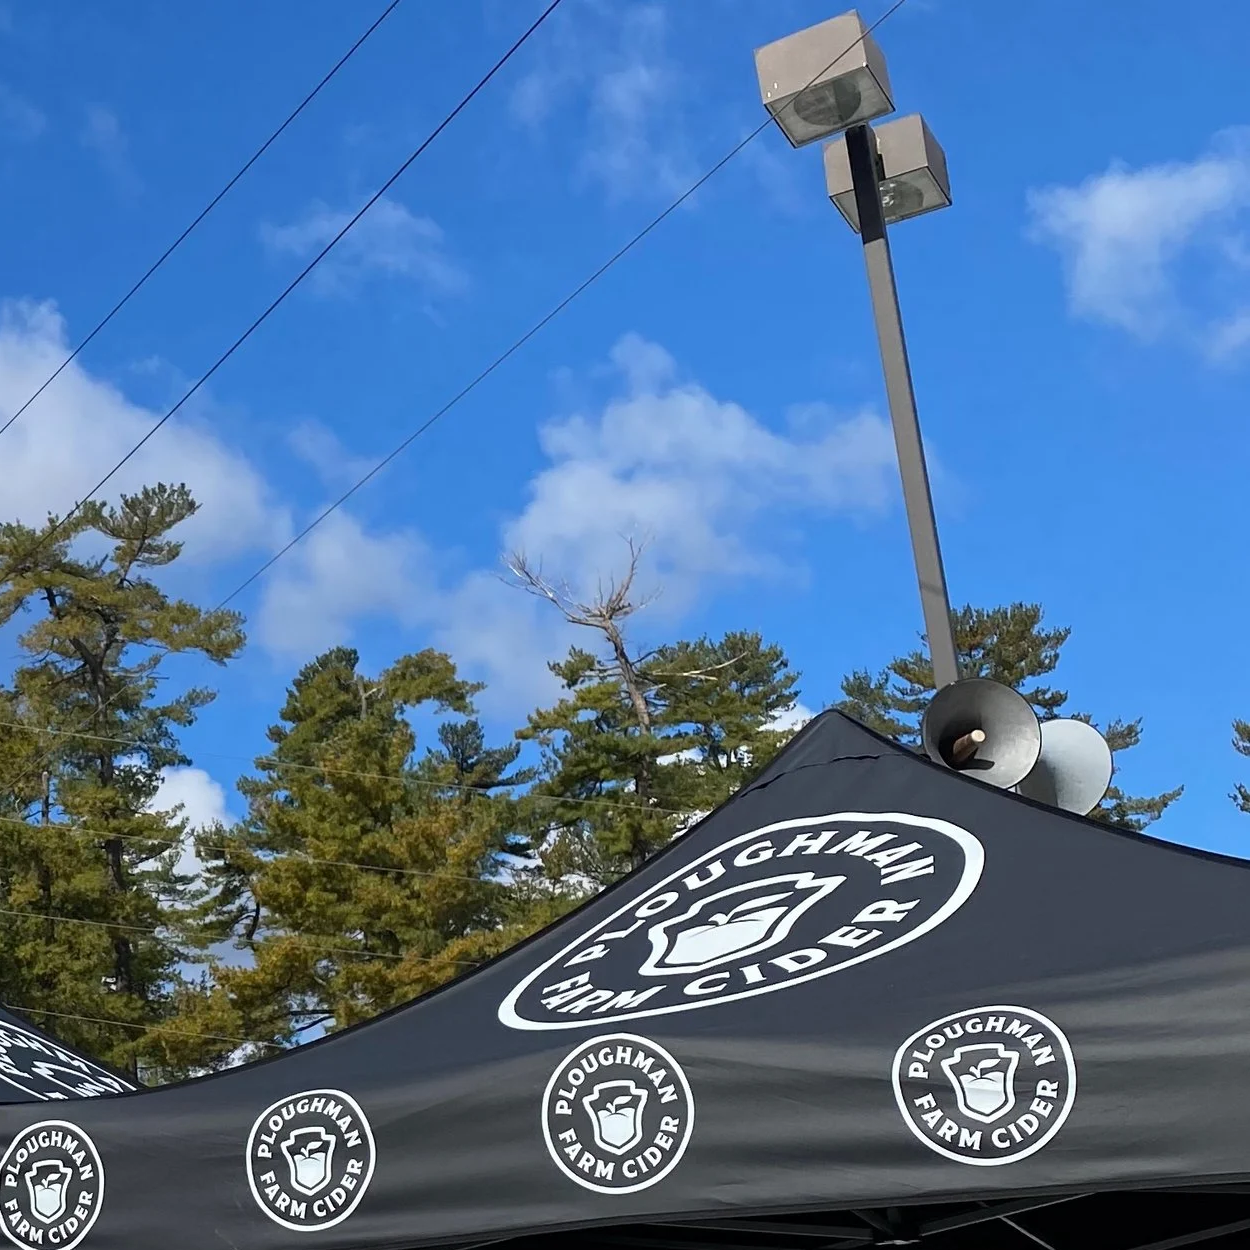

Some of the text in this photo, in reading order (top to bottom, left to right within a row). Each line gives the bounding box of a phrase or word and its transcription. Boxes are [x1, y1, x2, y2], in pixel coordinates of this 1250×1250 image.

[564, 830, 935, 968] PLOUGHMAN
[540, 898, 921, 1014] FARM CIDER
[908, 1015, 1056, 1080] PLOUGHMAN
[554, 1046, 678, 1116] PLOUGHMAN
[256, 1097, 362, 1160] PLOUGHMAN
[913, 1077, 1060, 1151] FARM CIDER
[4, 1130, 94, 1188] PLOUGHMAN
[556, 1115, 680, 1181] FARM CIDER
[4, 1189, 94, 1245] FARM CIDER
[259, 1157, 364, 1220] FARM CIDER
